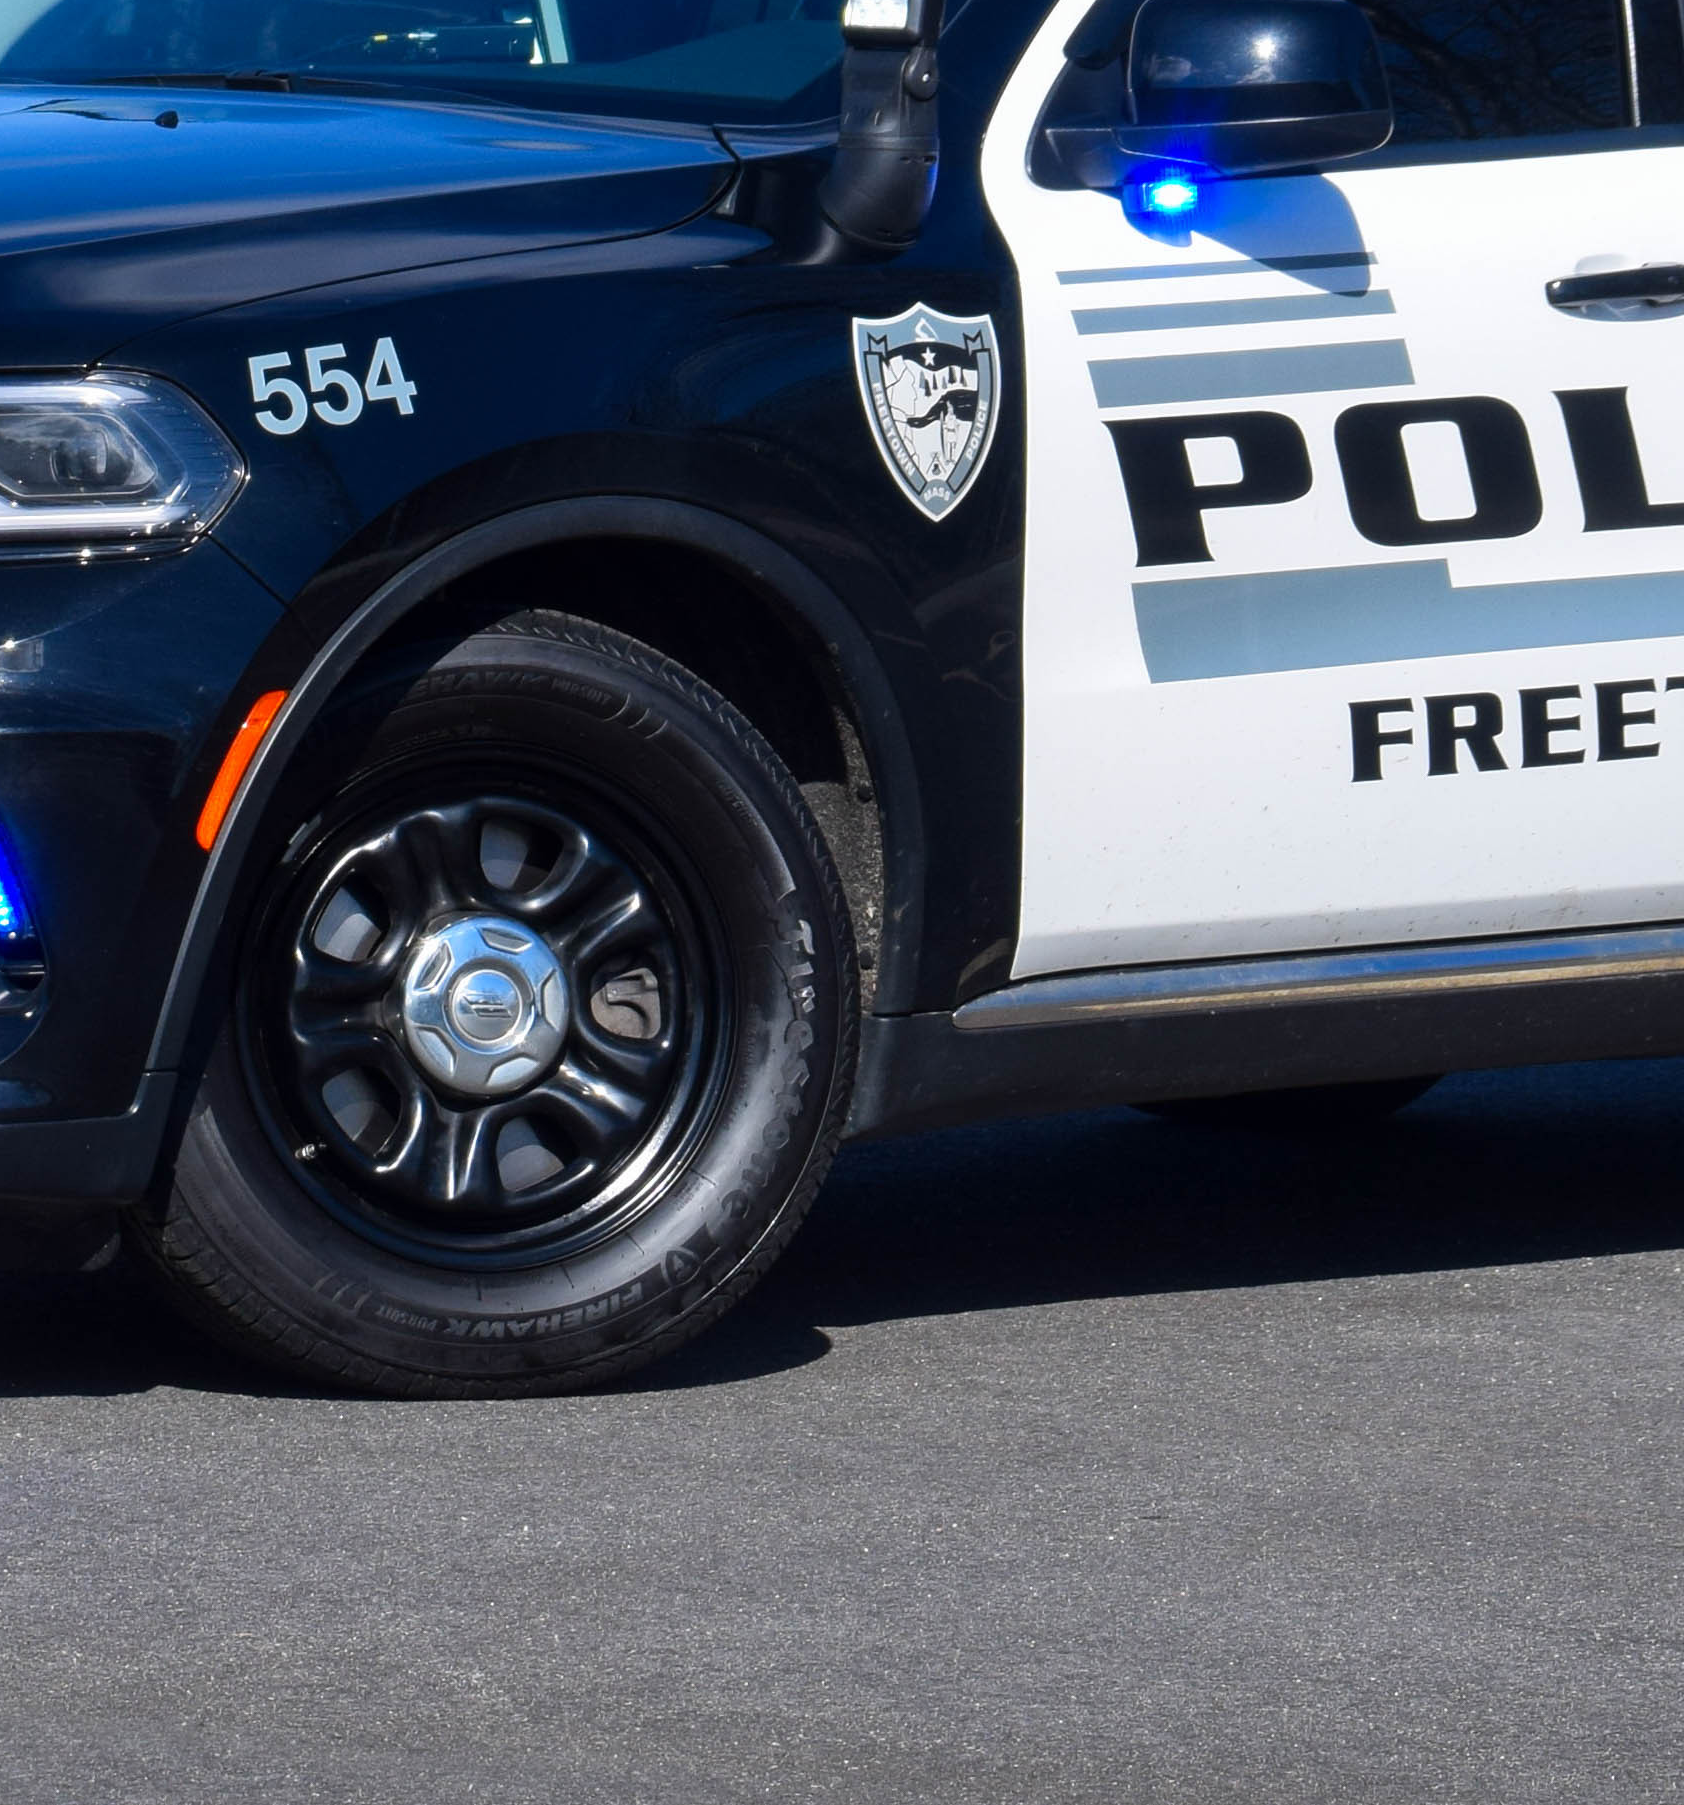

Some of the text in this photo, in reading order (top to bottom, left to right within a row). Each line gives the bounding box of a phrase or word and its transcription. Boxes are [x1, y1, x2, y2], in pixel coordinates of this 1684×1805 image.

[248, 336, 417, 435] 554
[871, 382, 917, 478] FREETOWN
[965, 399, 989, 461] POLICE
[442, 1280, 645, 1340] FIREHAWK
